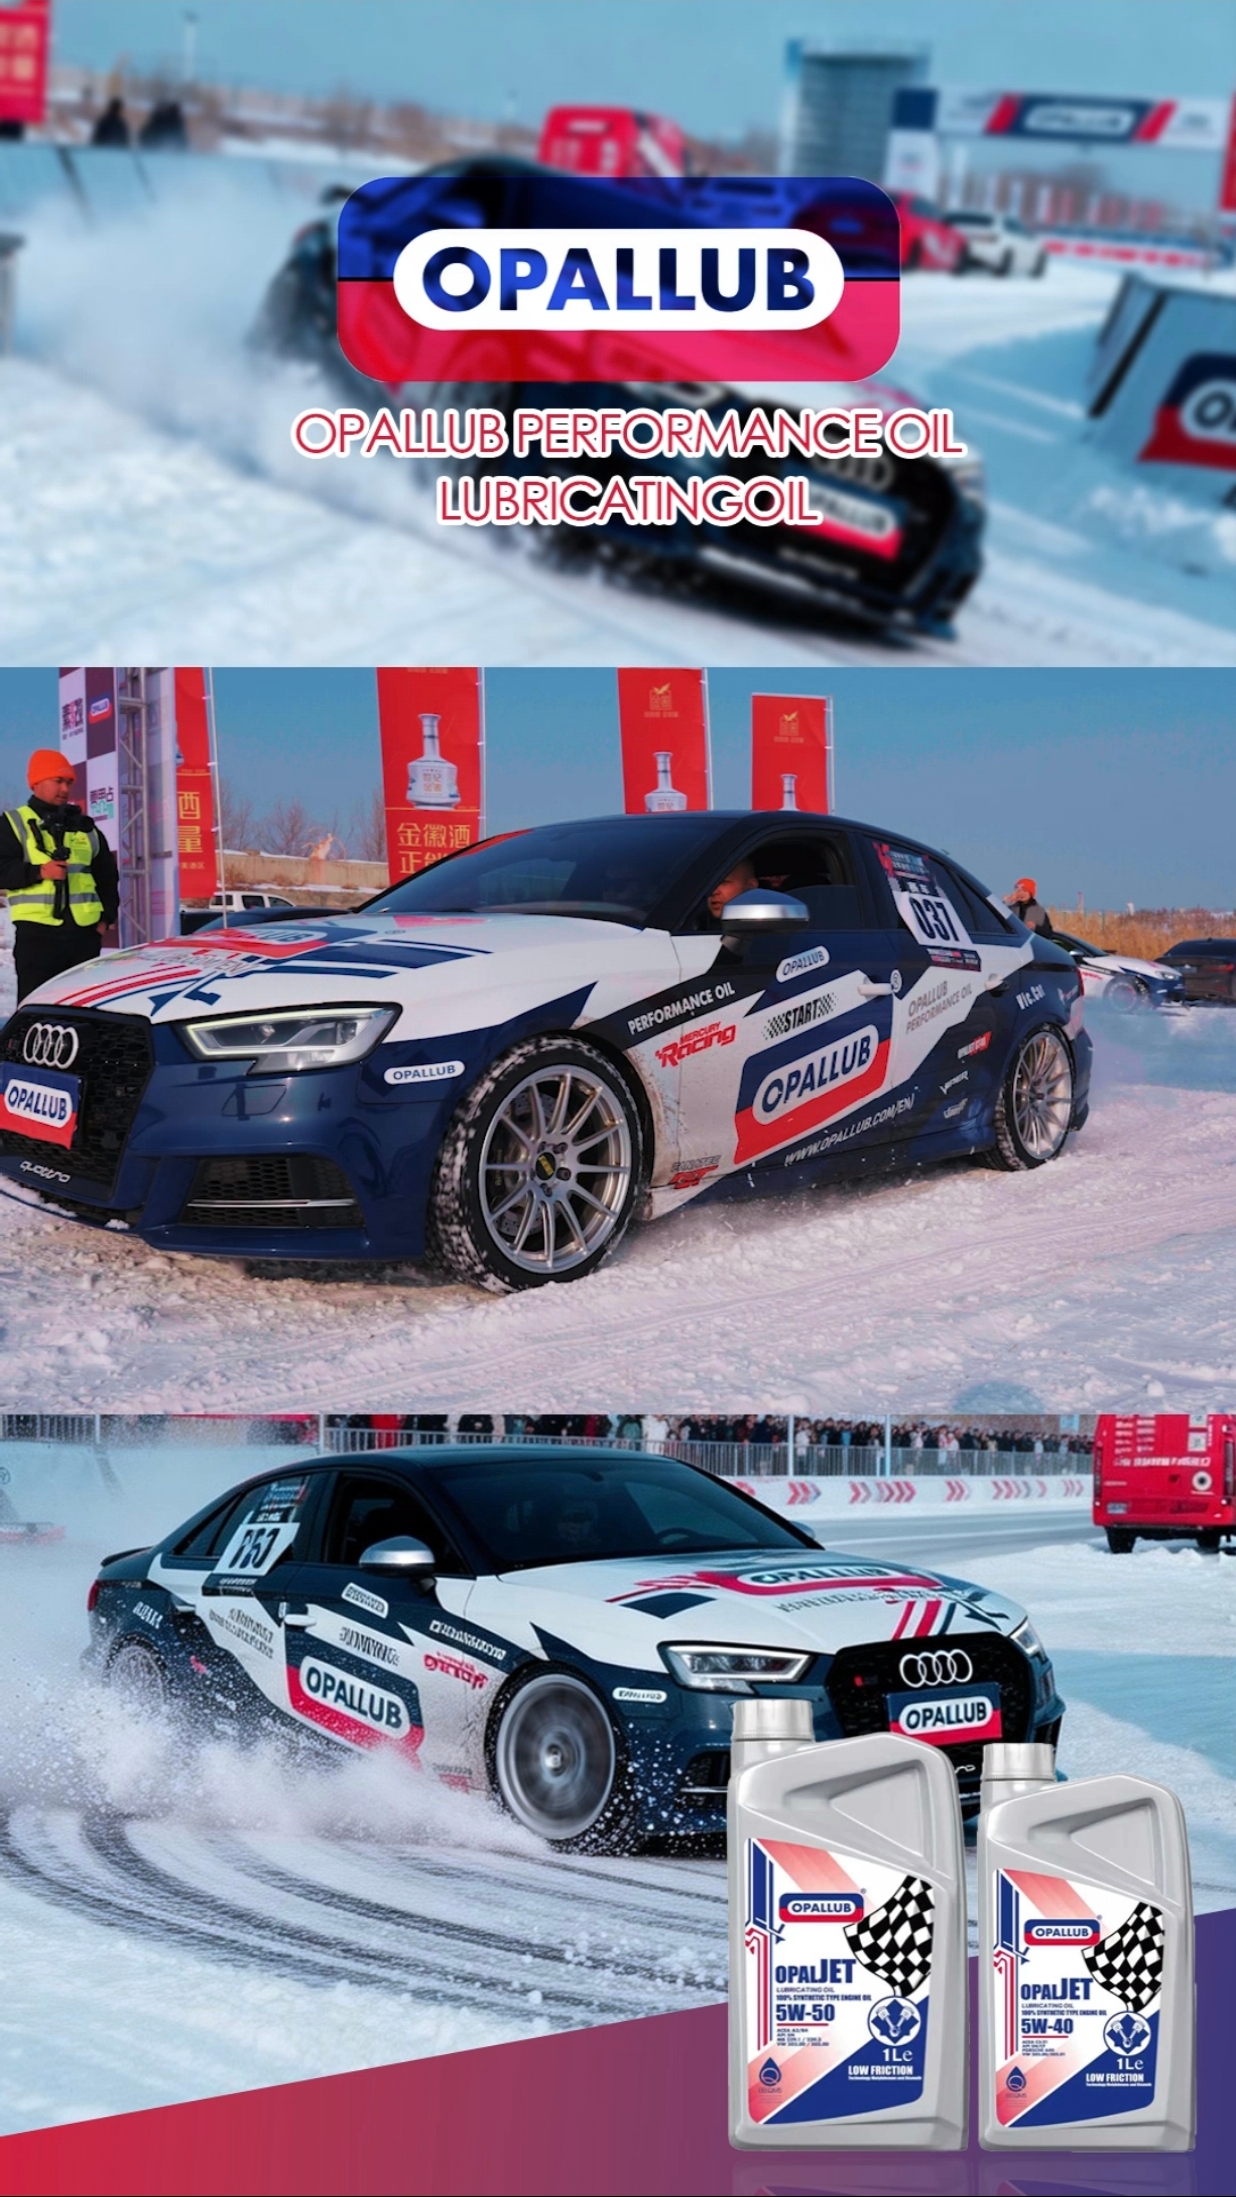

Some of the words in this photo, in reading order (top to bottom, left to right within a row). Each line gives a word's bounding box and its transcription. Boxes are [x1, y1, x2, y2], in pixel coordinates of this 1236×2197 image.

[397, 822, 470, 848] 金徽酒
[908, 896, 960, 942] 037
[782, 950, 825, 976] OPALLUB
[627, 988, 714, 1035] PERFORMANCE
[714, 981, 735, 1000] OIL
[908, 980, 947, 1017] OPALLUB
[906, 990, 960, 1035] PERFORMANCE
[679, 1021, 721, 1044] MERCURY
[655, 1024, 736, 1068] Racing
[393, 1064, 456, 1081] OPALLUB
[762, 1034, 871, 1113] OPALLUB
[8, 1086, 68, 1121] OPALLUB
[20, 1160, 71, 1184] quattro
[306, 1666, 403, 1729] OPALLUB
[905, 1701, 987, 1730] OPALLUB
[791, 1902, 852, 1913] OPALLUB
[1035, 1928, 1089, 1937] OPALLUB
[776, 2004, 836, 2021] 5W-50
[1021, 2018, 1074, 2034] 5W-40
[848, 2065, 869, 2075] LOW
[870, 2065, 913, 2075] FRICTION
[1086, 2073, 1105, 2082] LOW
[1106, 2073, 1144, 2082] FRICTION
